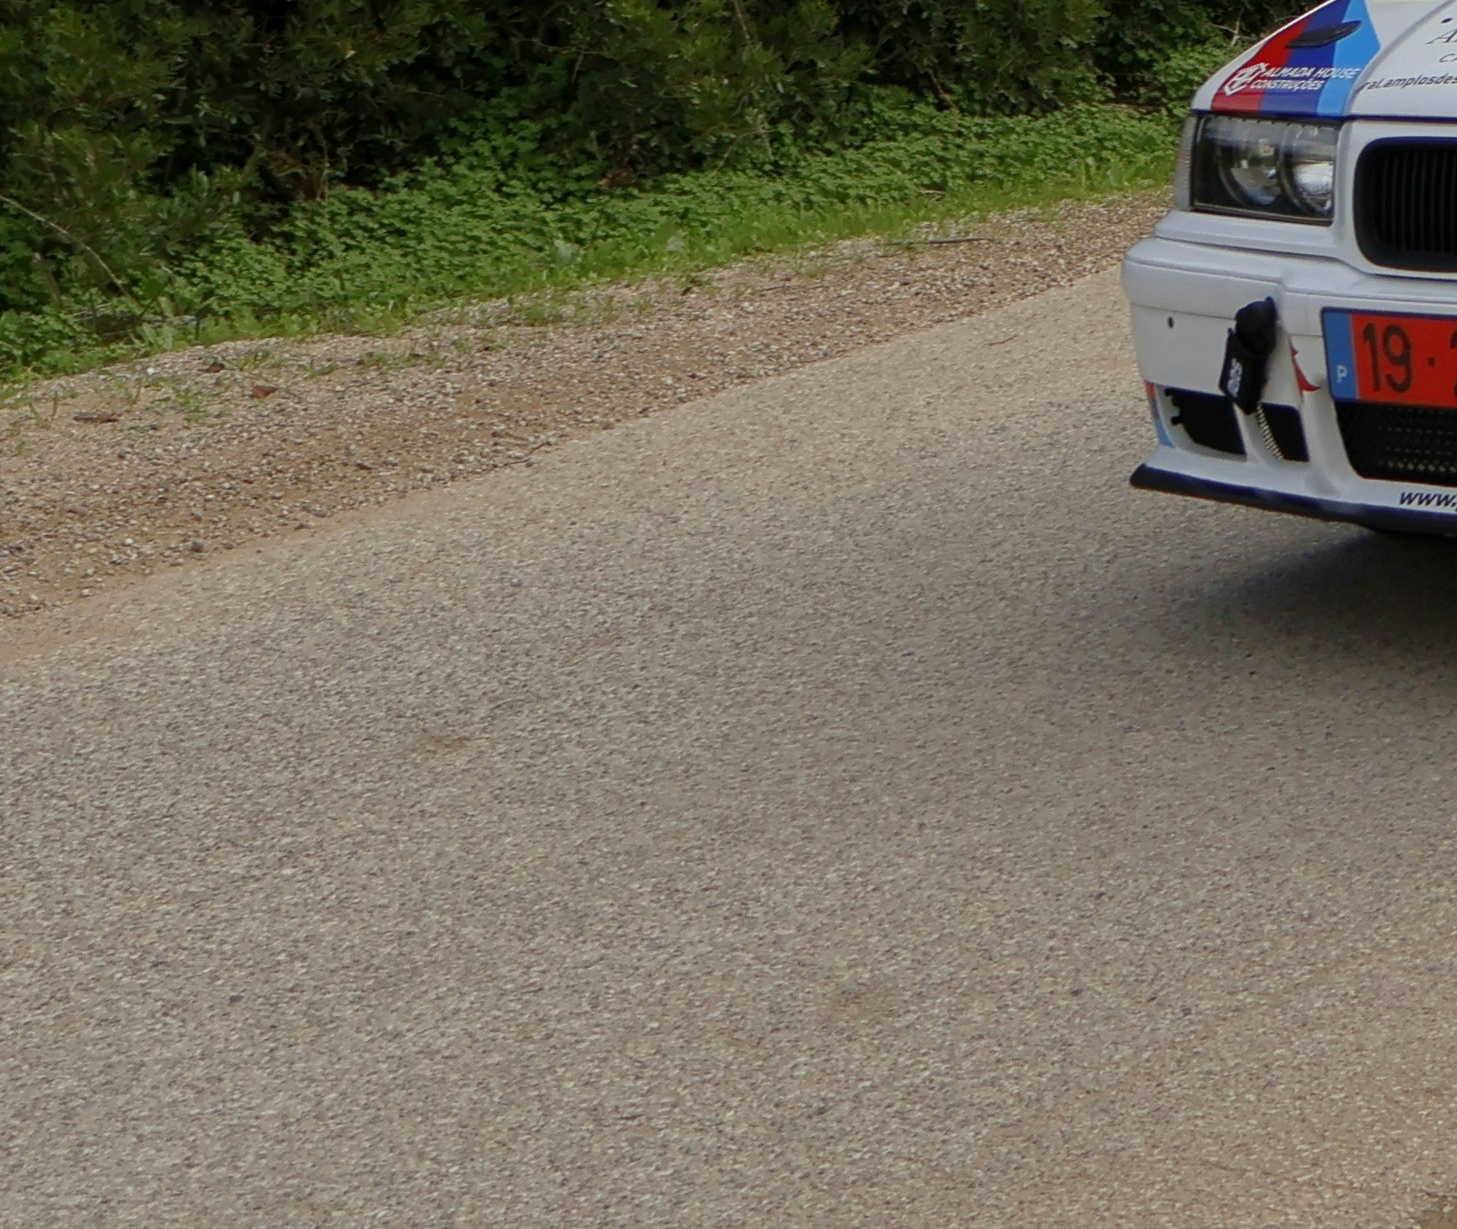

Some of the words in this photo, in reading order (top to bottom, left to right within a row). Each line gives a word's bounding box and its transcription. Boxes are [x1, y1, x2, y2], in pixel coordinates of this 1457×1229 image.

[1262, 66, 1314, 79] ALMADA
[1313, 68, 1361, 79] HOUSE
[1251, 78, 1325, 92] CONSTRUÇÕES
[1335, 364, 1348, 384] P
